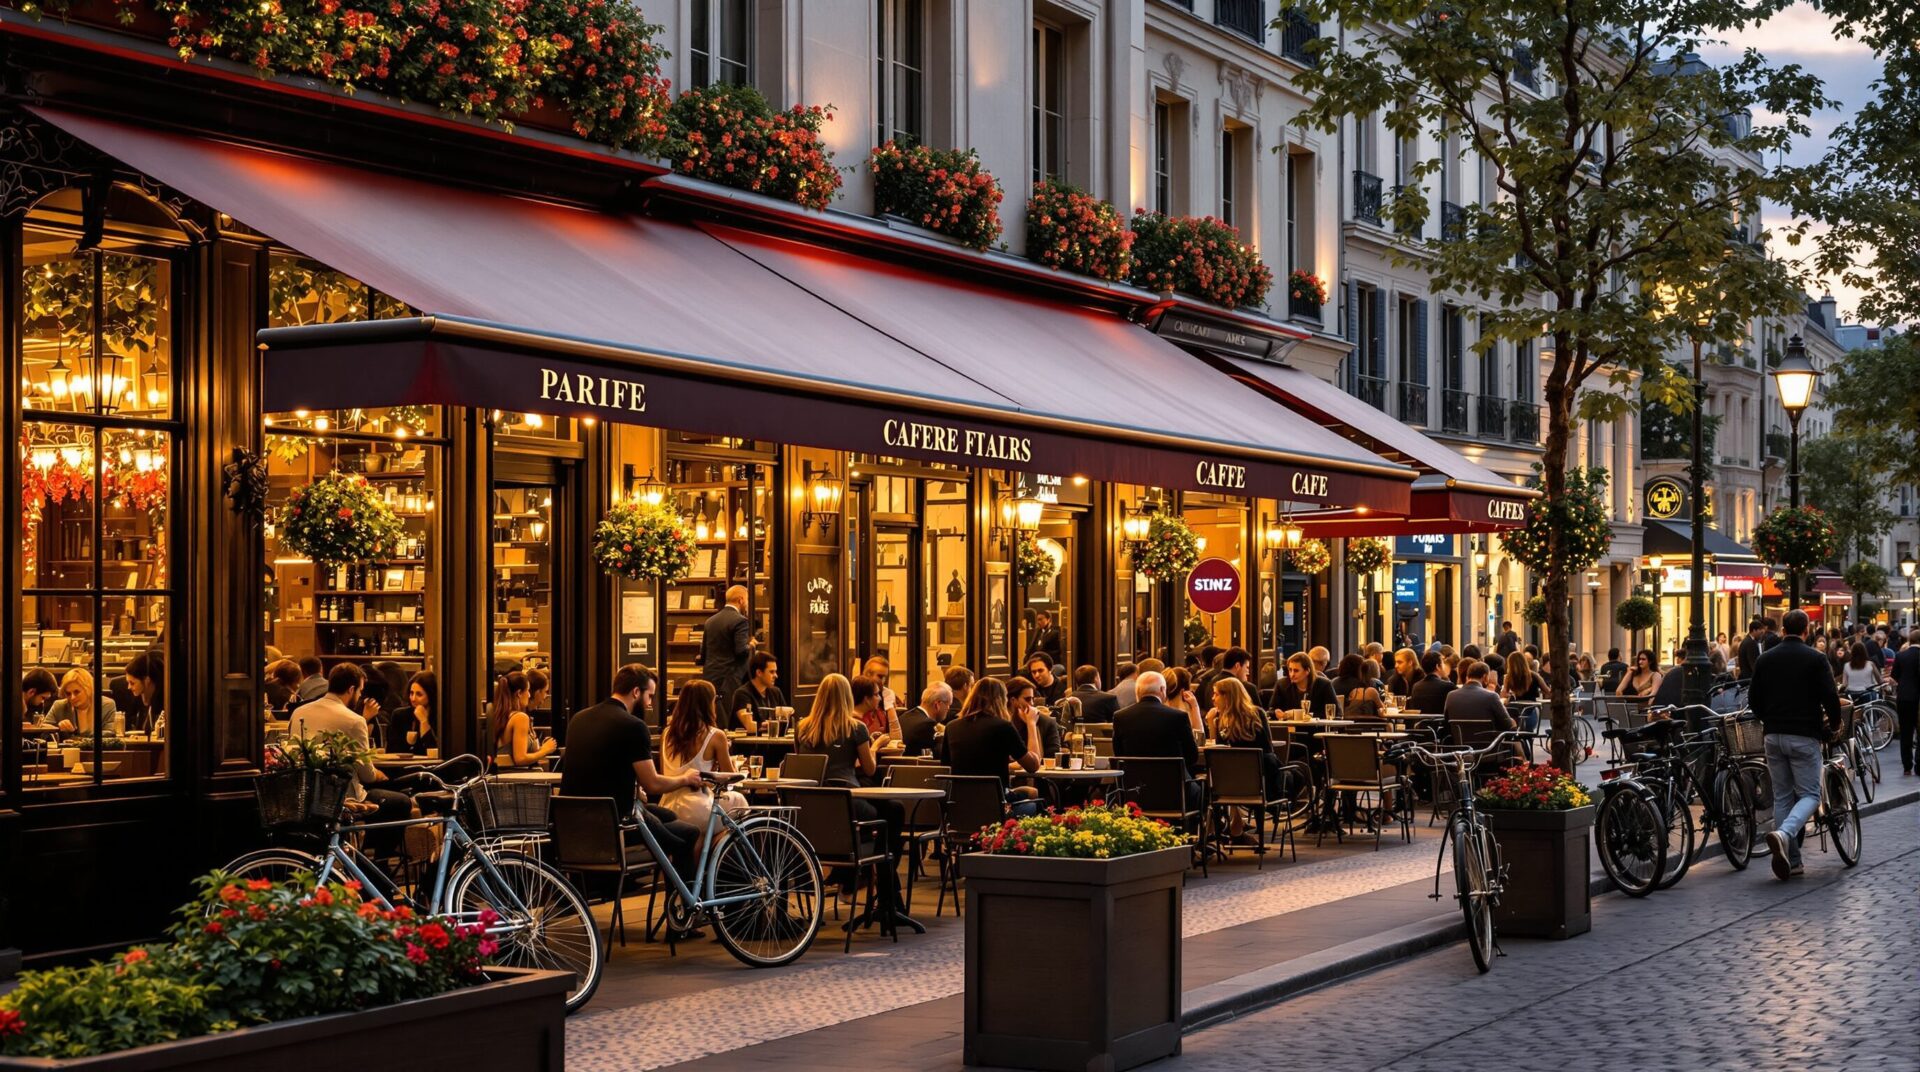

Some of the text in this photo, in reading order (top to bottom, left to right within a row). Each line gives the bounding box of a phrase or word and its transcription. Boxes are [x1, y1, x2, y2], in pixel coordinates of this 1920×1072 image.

[540, 368, 646, 412] PARIFE
[883, 419, 959, 453] CAFERE
[1196, 460, 1246, 489] CAFFE
[1291, 472, 1328, 497] CAFE
